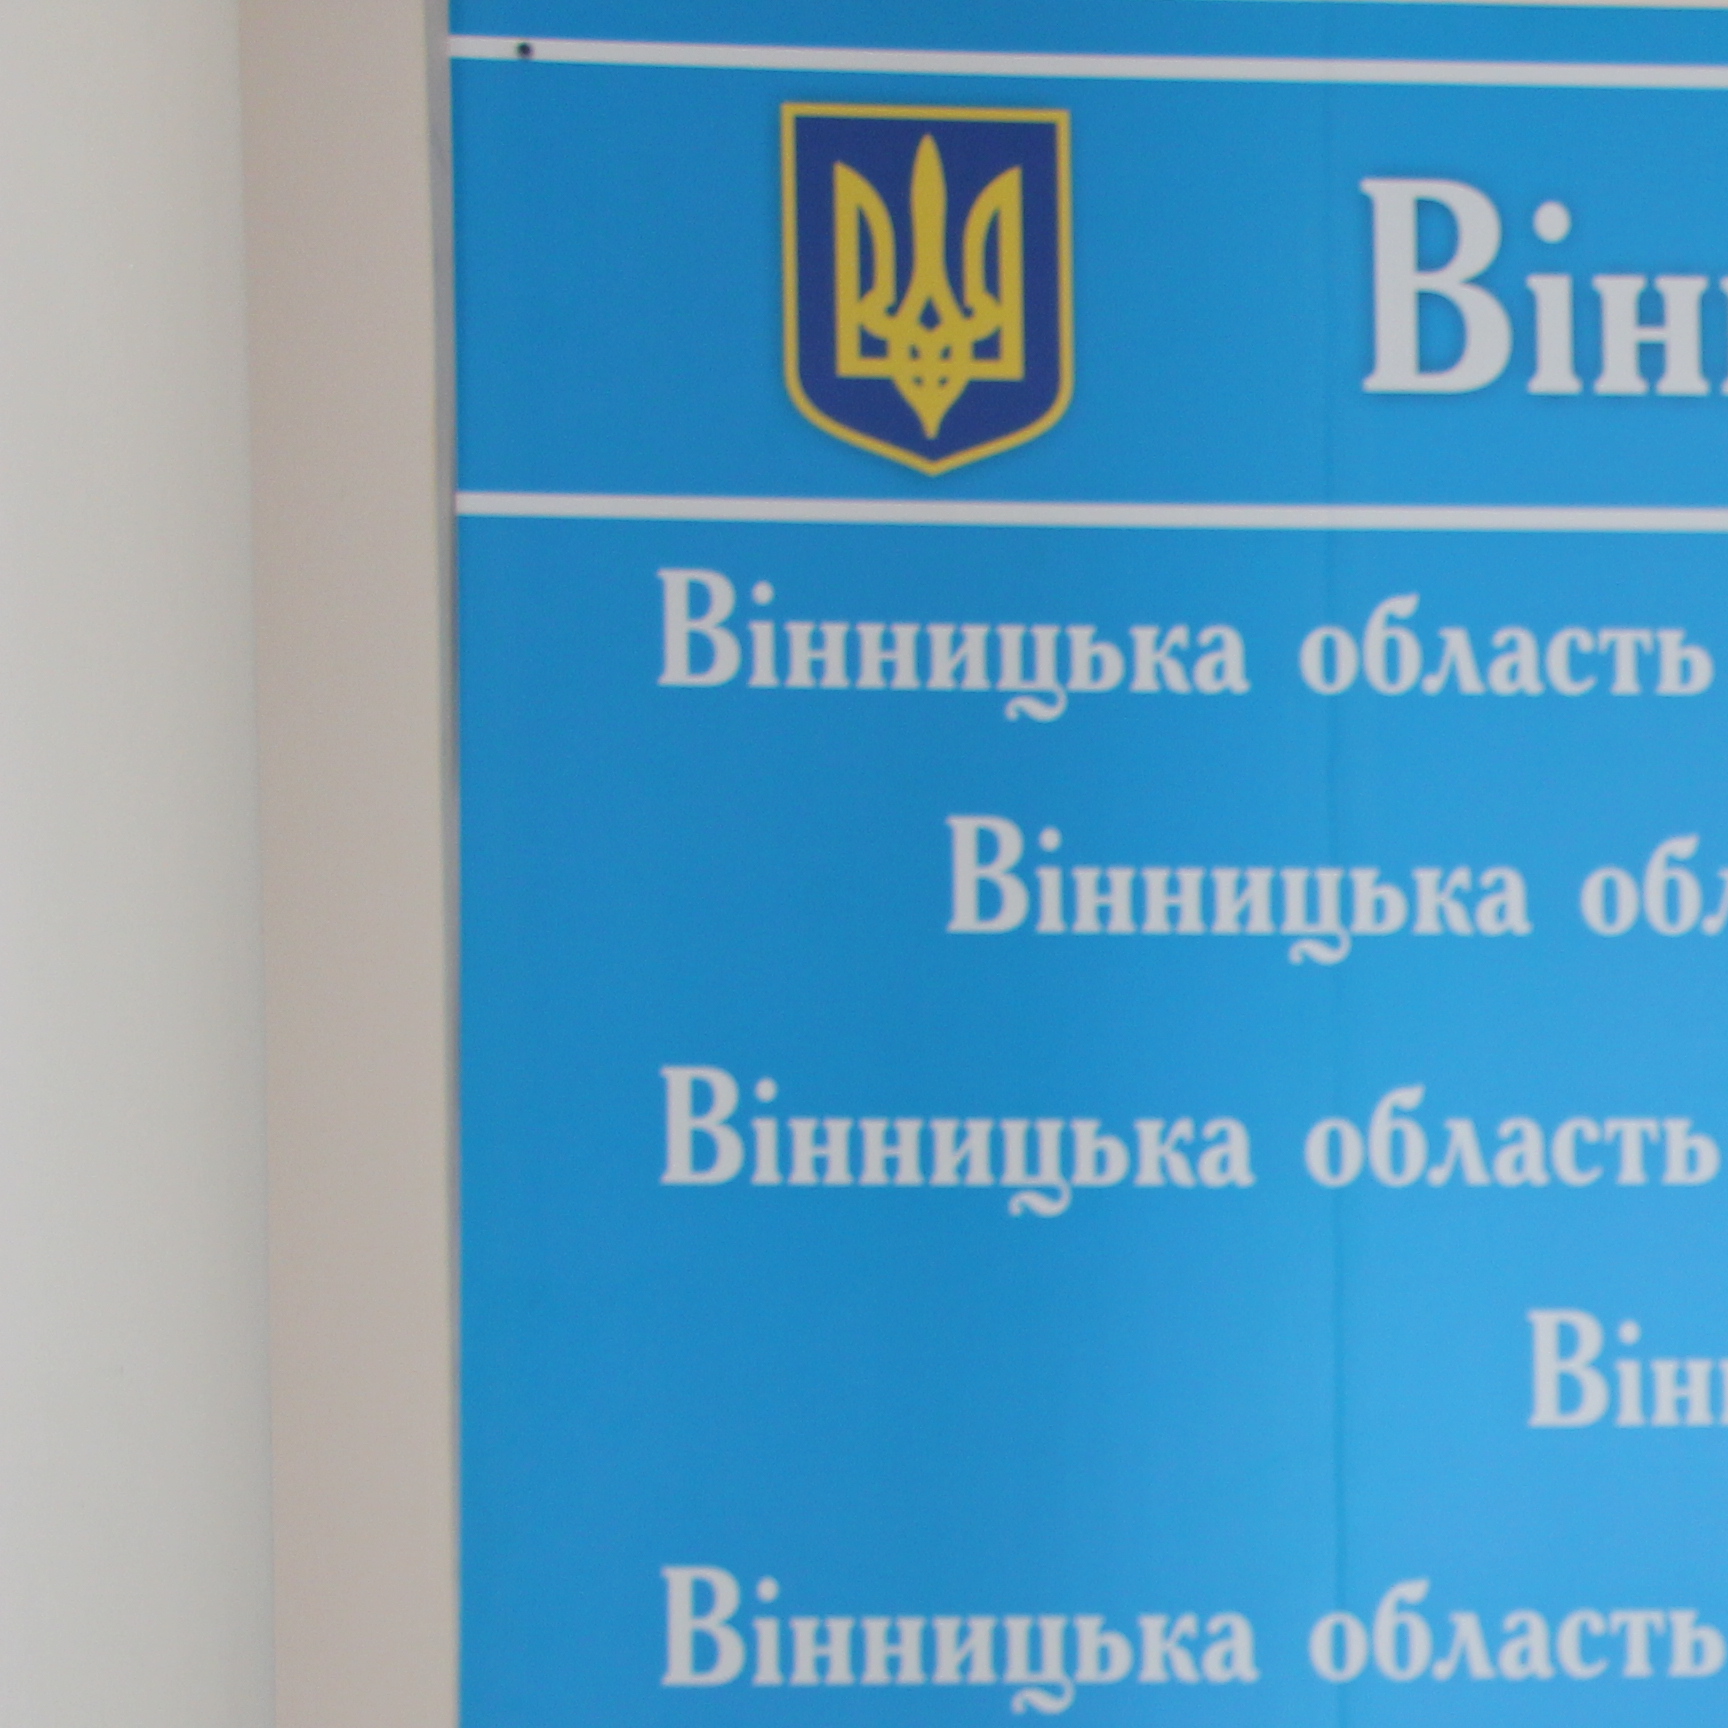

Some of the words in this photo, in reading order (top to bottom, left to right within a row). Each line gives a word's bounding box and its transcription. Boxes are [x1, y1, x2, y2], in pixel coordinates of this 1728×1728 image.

[659, 569, 1249, 720] Вінницька
[1301, 595, 1713, 694] область
[948, 816, 1531, 963] Вінницька
[662, 1067, 1253, 1215] Вінницька
[1306, 1086, 1719, 1186] область
[663, 1567, 1258, 1713] Вінницька
[1310, 1580, 1726, 1681] область
